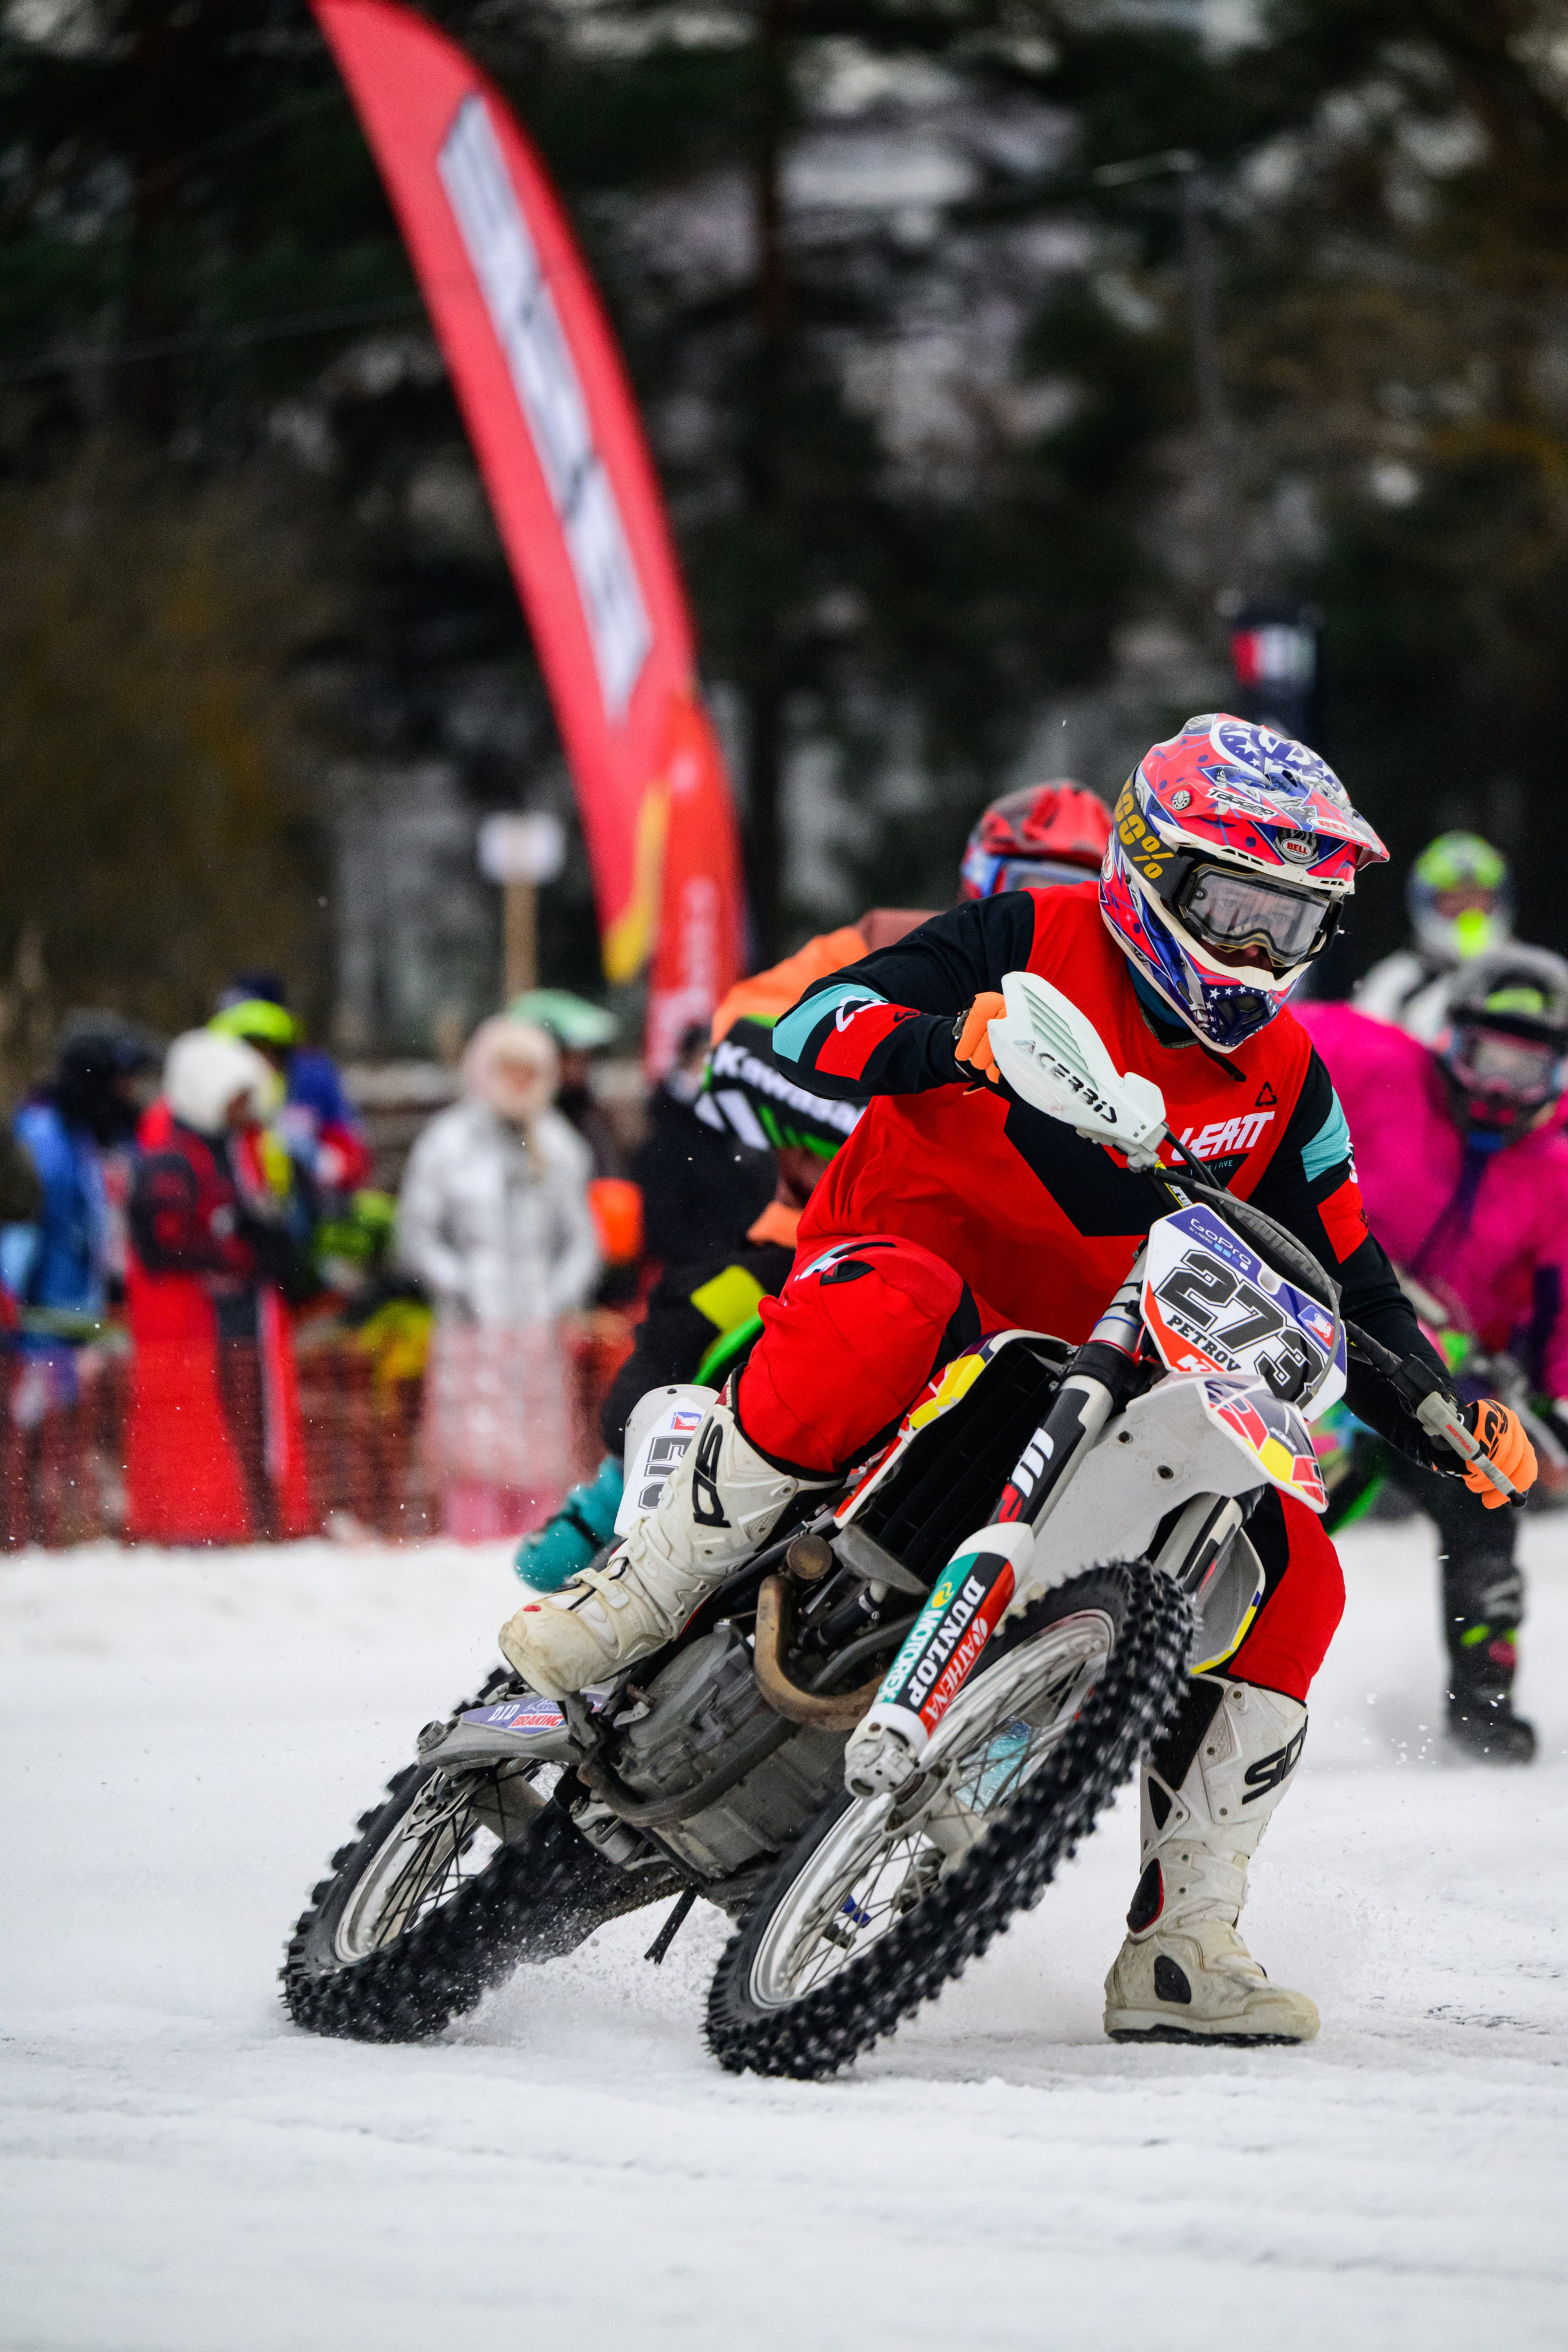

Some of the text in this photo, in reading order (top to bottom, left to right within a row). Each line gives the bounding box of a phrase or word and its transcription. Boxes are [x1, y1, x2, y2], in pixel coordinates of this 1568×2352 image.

[1287, 842, 1308, 854] BELL
[712, 1041, 866, 1136] Kawasa
[1171, 1111, 1275, 1162] LEATT
[1190, 1218, 1251, 1265] GoPro
[1153, 1250, 1326, 1404] 273
[1166, 1314, 1241, 1371] PETROV
[878, 1610, 944, 1702] MOTOREX
[908, 1575, 986, 1707] DUNLOP
[925, 1634, 976, 1719] ATHENA
[510, 1715, 564, 1727] BRAKING
